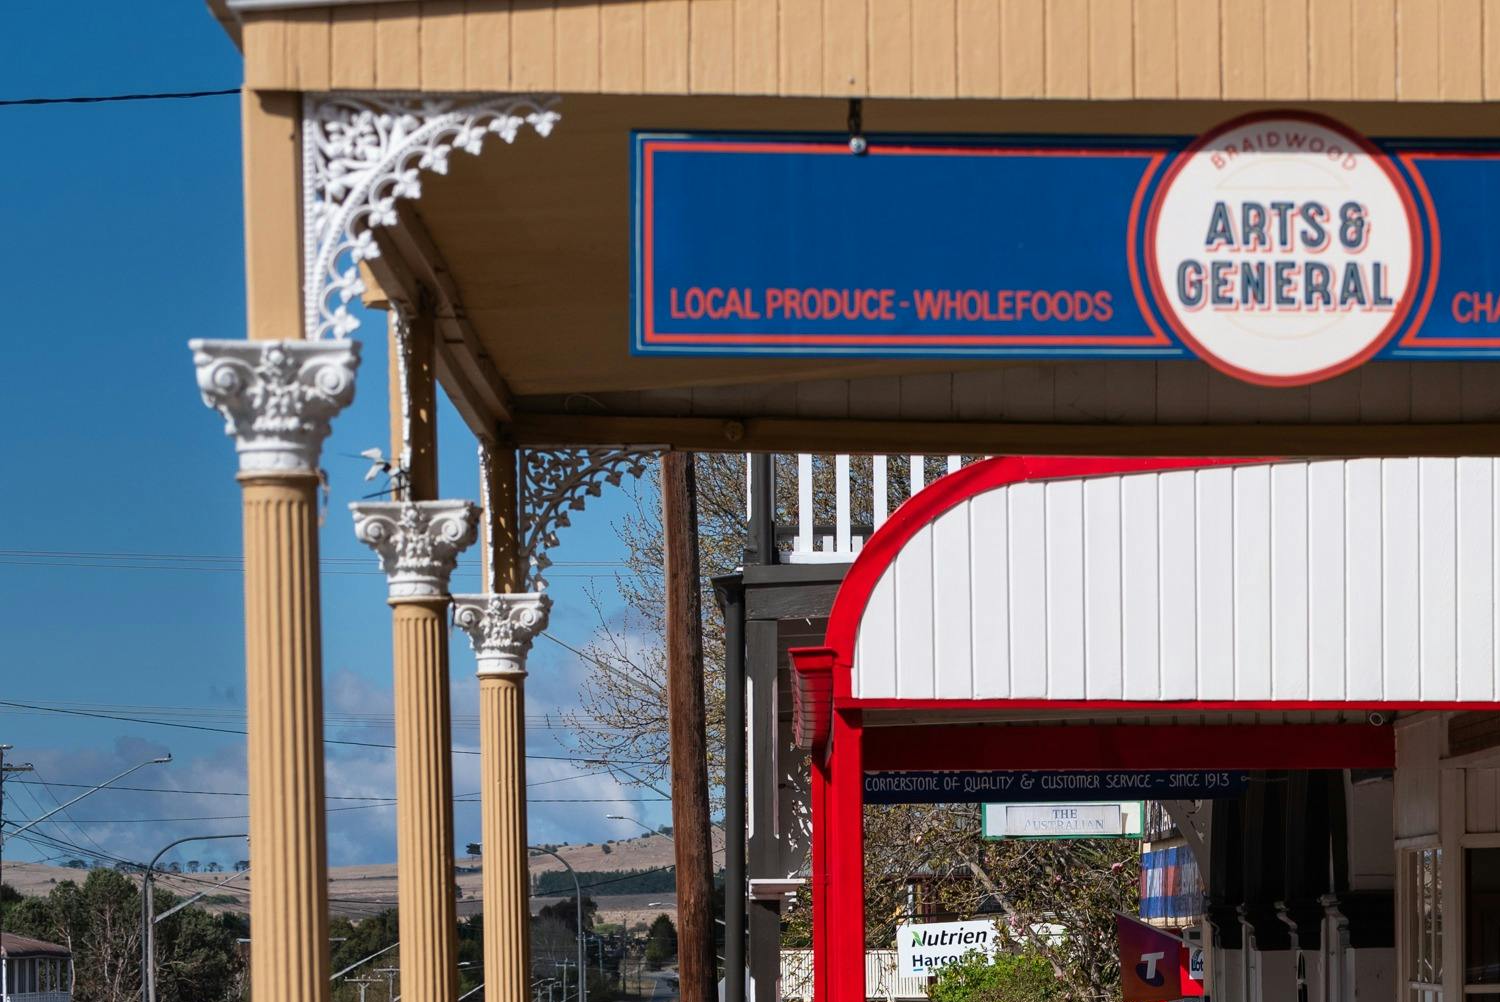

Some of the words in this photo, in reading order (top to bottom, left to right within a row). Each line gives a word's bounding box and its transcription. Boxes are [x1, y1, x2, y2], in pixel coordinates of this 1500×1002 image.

[1210, 131, 1357, 171] BRAIDWOOD
[1205, 201, 1331, 253] ARTS
[1339, 201, 1370, 253] &
[1177, 260, 1395, 313] GENERAL
[670, 287, 760, 321] LOCAL
[865, 777, 940, 791] CORNERSTONE
[944, 777, 960, 790] OF
[964, 775, 1014, 792] QUALITY
[1020, 774, 1035, 789] &
[1041, 775, 1100, 789] CUSTOMER
[1105, 774, 1151, 789] SERVICE
[1169, 773, 1200, 788] SINCE
[1205, 773, 1229, 789] 1913
[1025, 819, 1104, 830] AUSTRALIAN
[1052, 809, 1078, 819] THE
[911, 927, 987, 947] Nutrien
